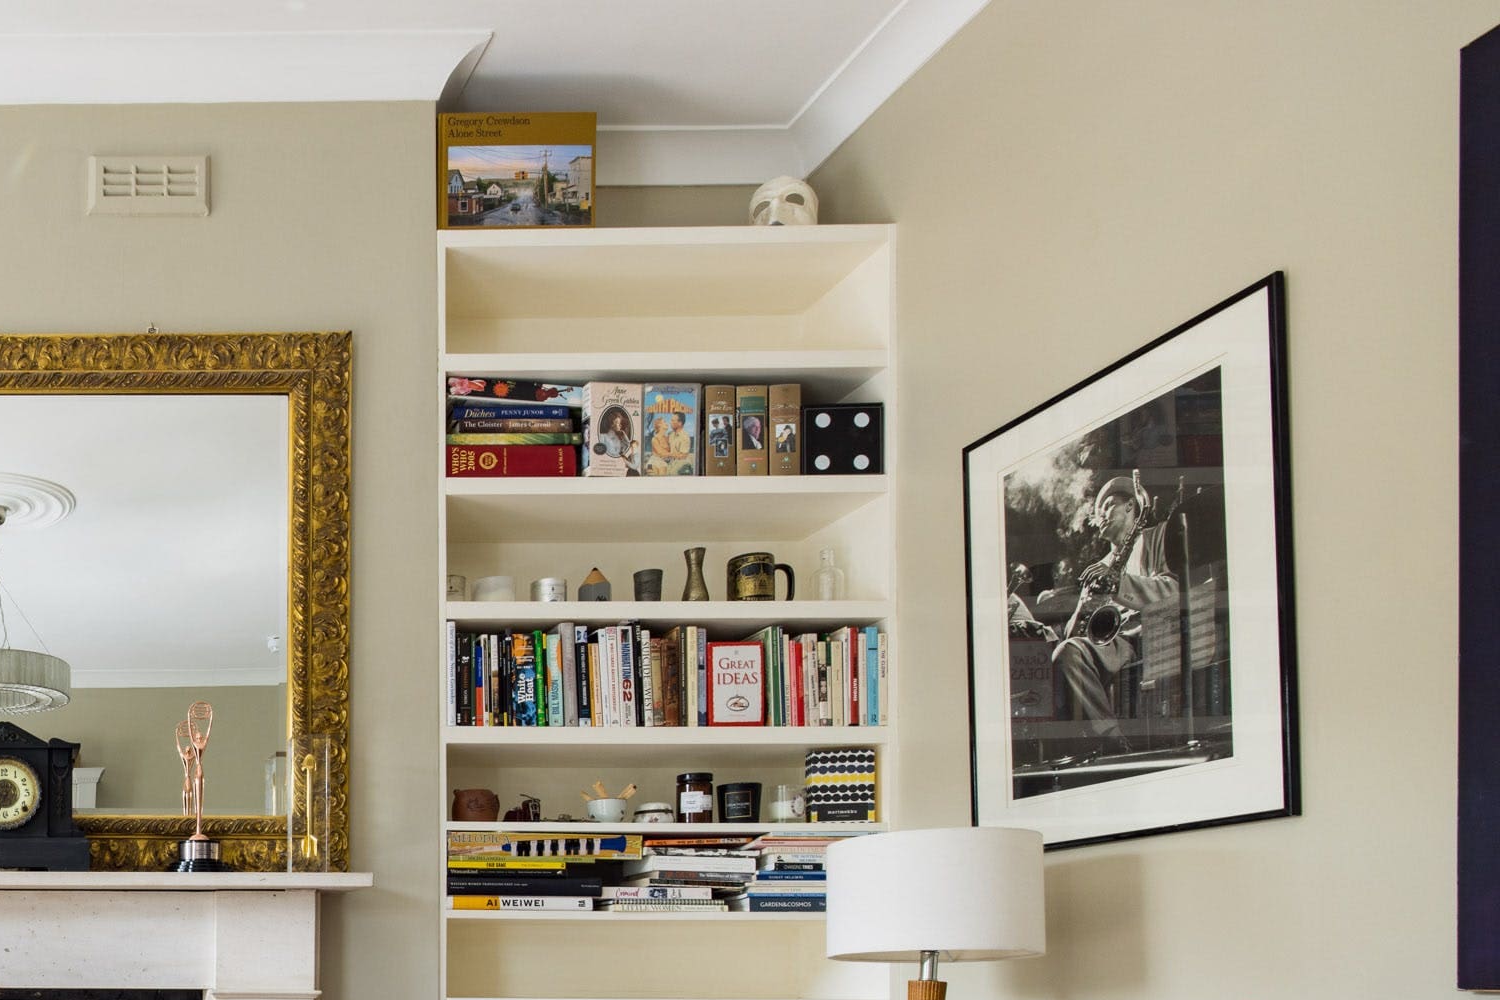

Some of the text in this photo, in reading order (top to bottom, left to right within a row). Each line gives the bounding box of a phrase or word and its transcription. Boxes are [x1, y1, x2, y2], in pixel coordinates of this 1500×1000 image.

[447, 116, 530, 129] Gregory Crewdson
[447, 129, 502, 138] Alone Street
[464, 409, 496, 418] Duchess
[451, 447, 460, 475] WHO'S
[459, 450, 467, 472] WHO
[467, 450, 476, 471] 2005
[621, 643, 632, 702] MANHATTAN 62
[718, 657, 756, 670] GREAT
[643, 641, 652, 712] SUICIDE WEST
[717, 672, 758, 685] IDEAS
[517, 673, 526, 704] White
[526, 678, 534, 702] Heat
[551, 679, 559, 715] BILL MASON
[486, 899, 545, 907] AI WEIWEI
